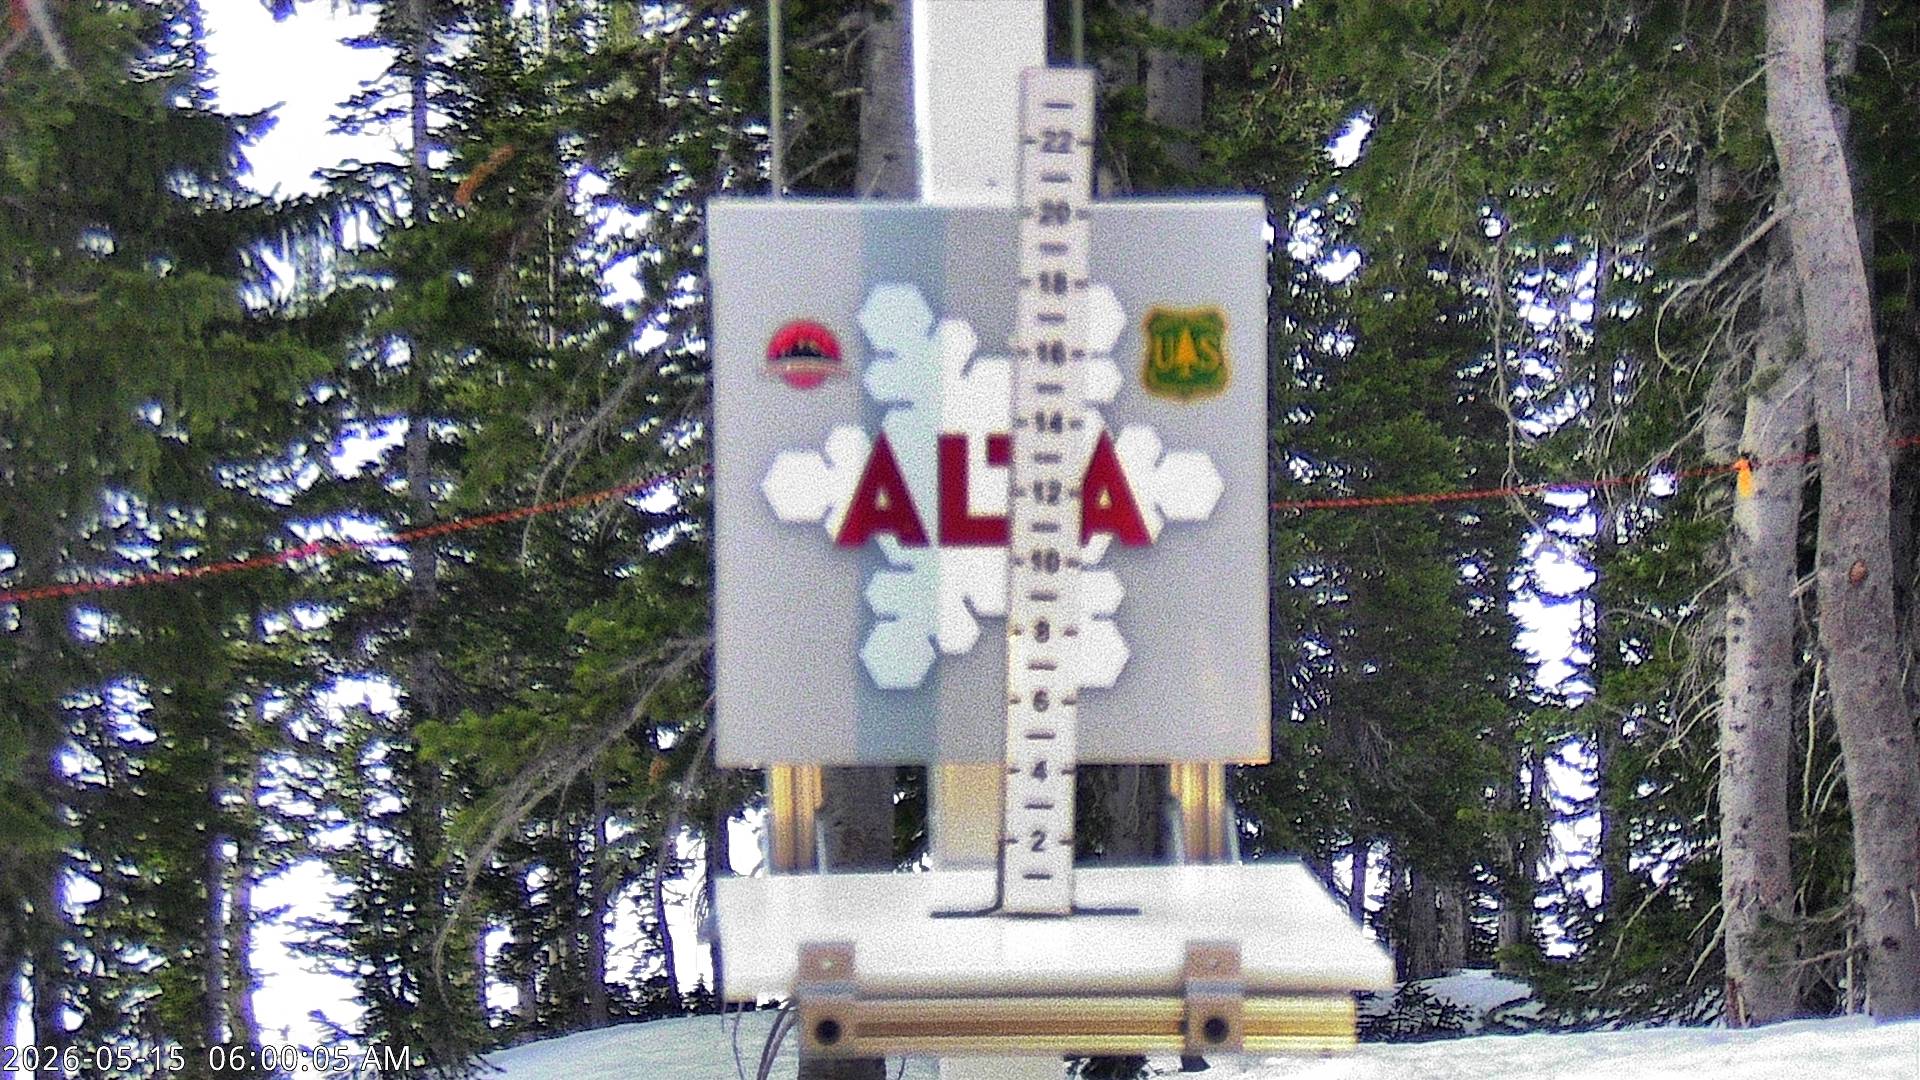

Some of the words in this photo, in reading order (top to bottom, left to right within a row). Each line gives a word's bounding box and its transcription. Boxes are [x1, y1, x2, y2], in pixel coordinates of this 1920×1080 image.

[1041, 131, 1072, 153] 22
[1039, 201, 1070, 225] 20
[1155, 335, 1223, 371] US
[834, 430, 1152, 547] ALA
[1031, 548, 1060, 573] 10
[1034, 620, 1050, 643] 8
[1032, 690, 1049, 713] 6
[1031, 760, 1048, 781] 4
[1030, 829, 1046, 852] 2
